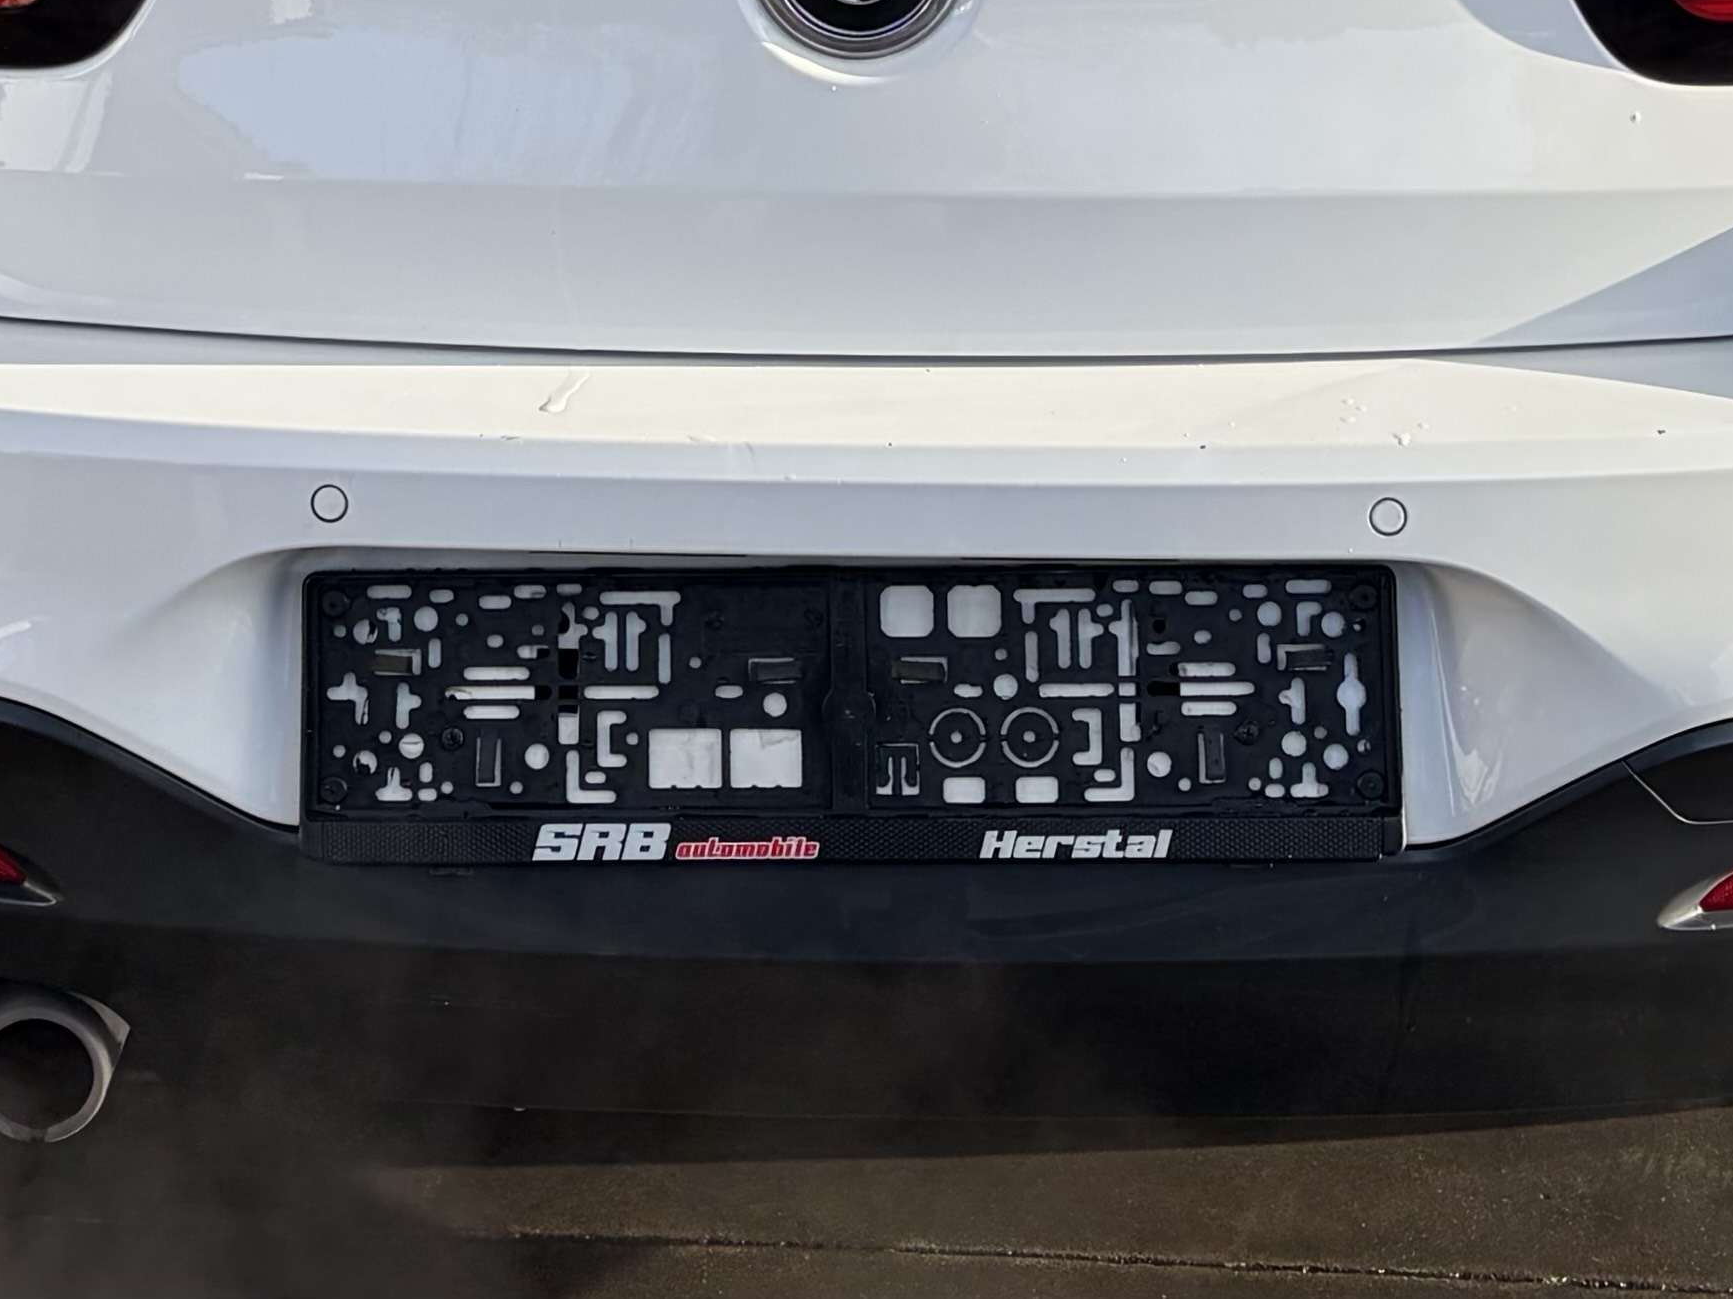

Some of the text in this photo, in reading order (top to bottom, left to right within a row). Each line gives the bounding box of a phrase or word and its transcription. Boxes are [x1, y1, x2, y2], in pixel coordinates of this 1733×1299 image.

[532, 823, 1173, 860] SRB automobile Herstal
